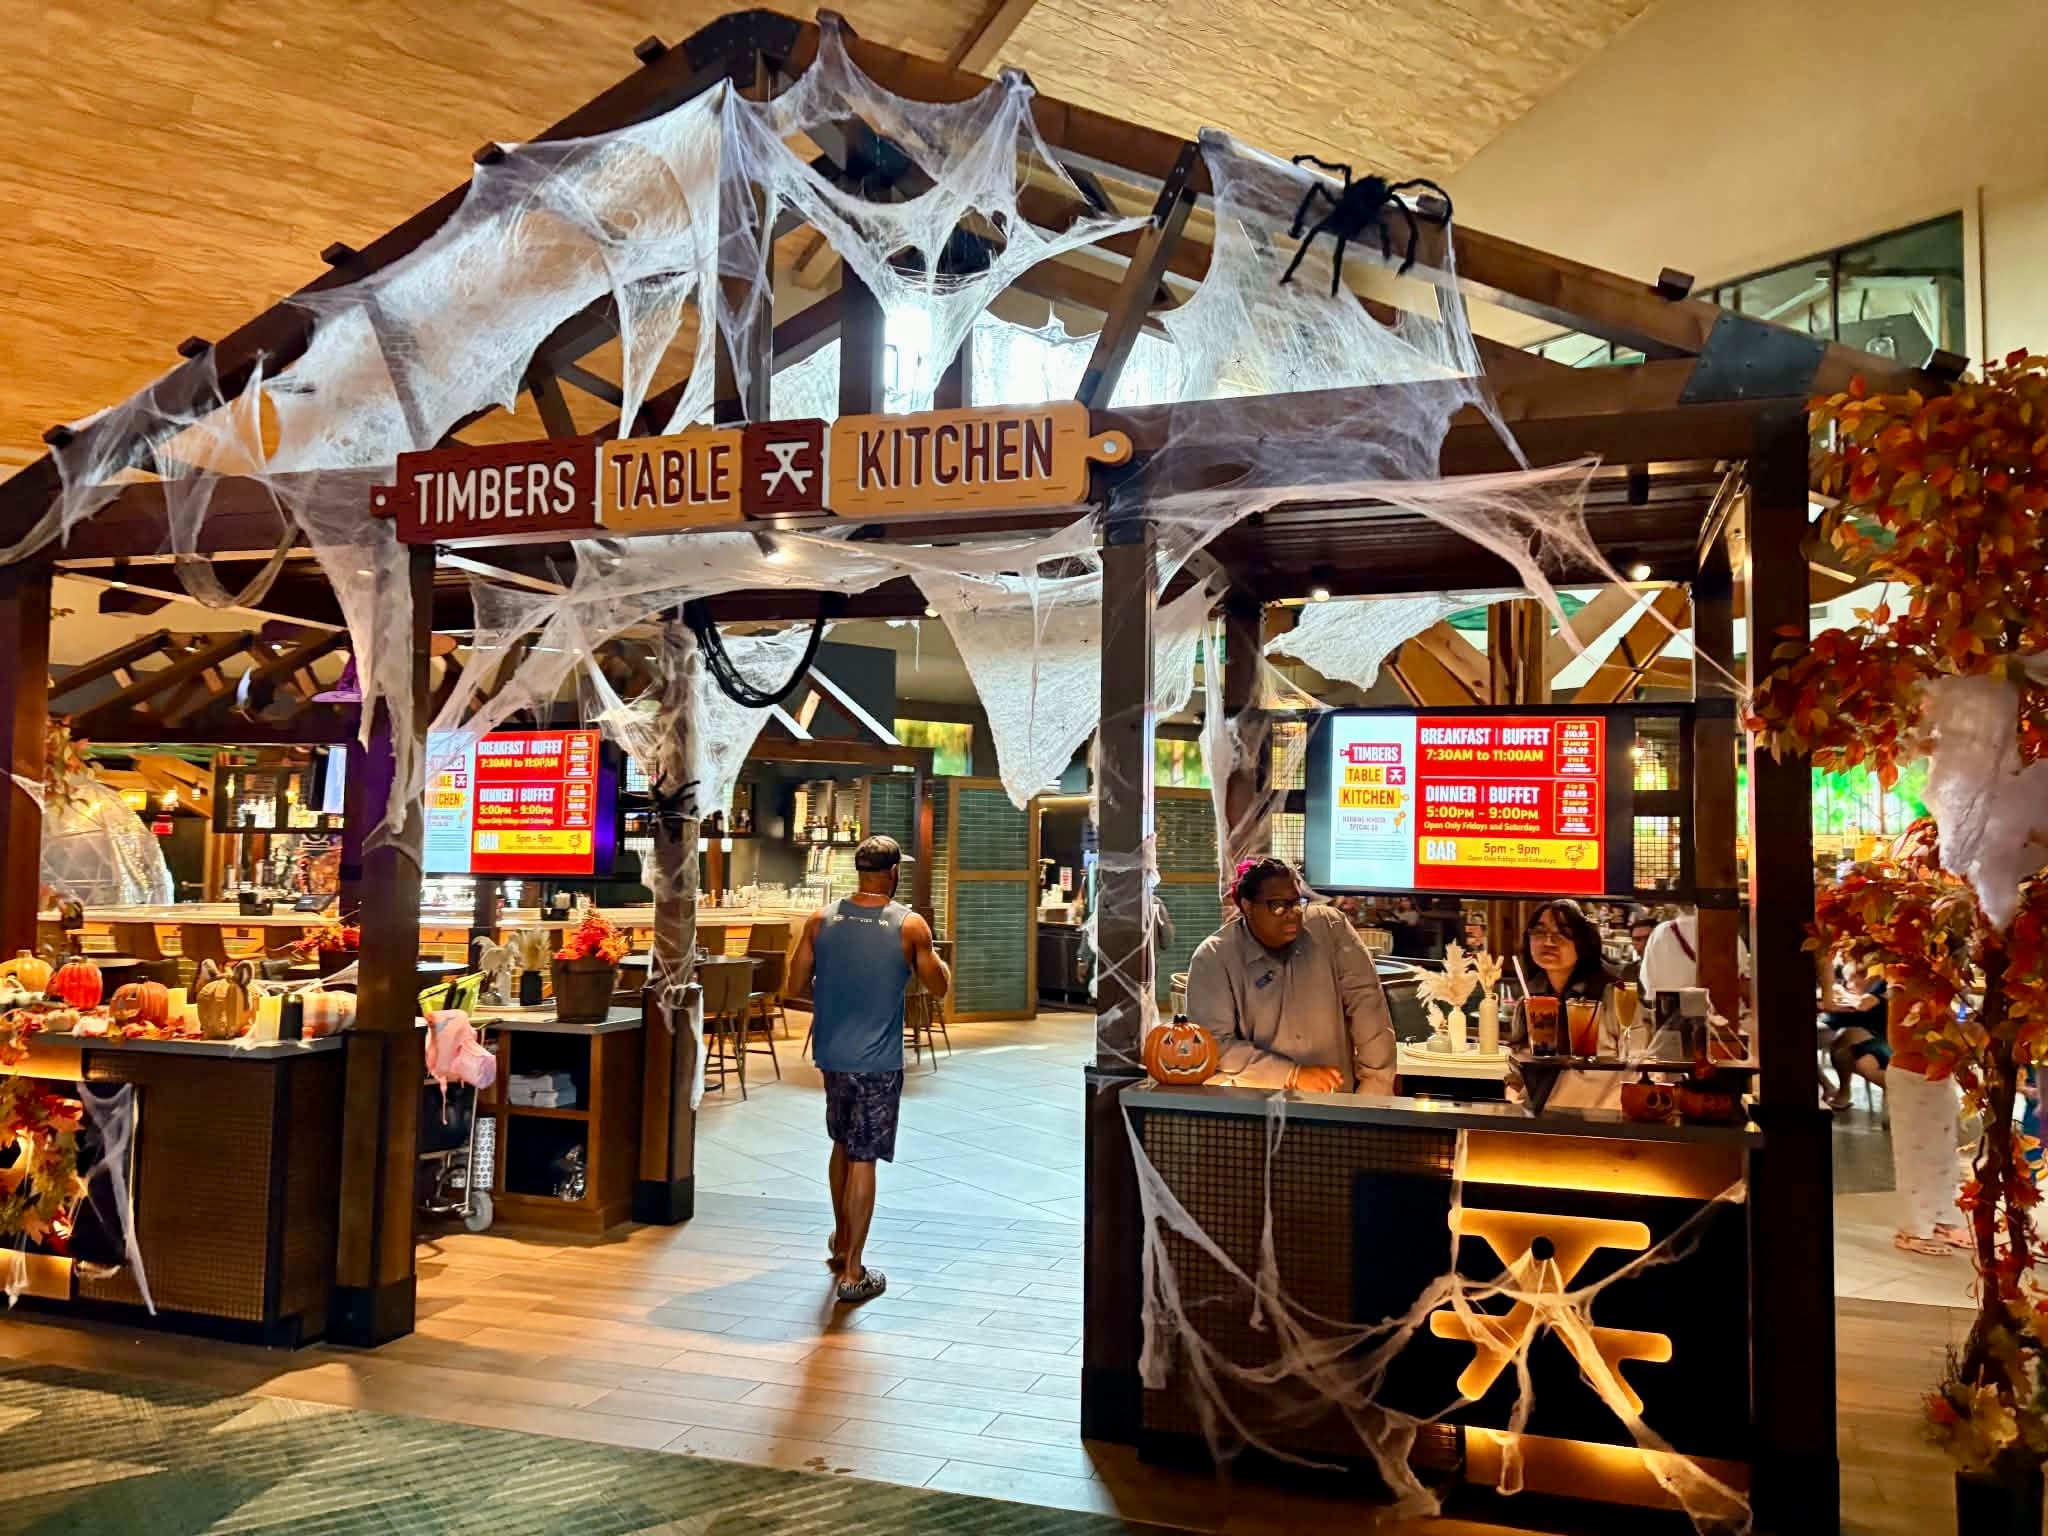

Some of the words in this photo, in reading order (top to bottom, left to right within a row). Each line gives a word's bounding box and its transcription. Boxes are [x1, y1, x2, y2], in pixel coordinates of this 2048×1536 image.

[414, 459, 577, 526] TIMBERS
[610, 445, 731, 510] TABLE
[858, 417, 1054, 491] KITCHEN
[1421, 728, 1491, 745] BREAKFAST
[1502, 728, 1551, 745] BUFFET
[1352, 746, 1399, 761] TIMBERS
[1425, 749, 1473, 760] 7:30AM
[1477, 750, 1490, 761] to
[1493, 750, 1544, 761] 11:00AM
[1348, 769, 1381, 781] TABLE
[520, 788, 555, 803] BUFFET
[1343, 790, 1395, 805] KITCHEN
[1425, 785, 1477, 803] DINNER
[1489, 786, 1541, 804] BUFFET
[1426, 806, 1474, 818] 5:00PM
[1489, 807, 1539, 820] 9:00PM
[1424, 821, 1444, 830] Open
[1445, 821, 1462, 830] Only
[1462, 822, 1487, 832] Fridays
[1490, 822, 1503, 830] and
[1504, 823, 1540, 833] Saturdays
[1426, 840, 1457, 861] BAR
[1484, 843, 1507, 856] 5pm
[1517, 844, 1540, 857] 9pm
